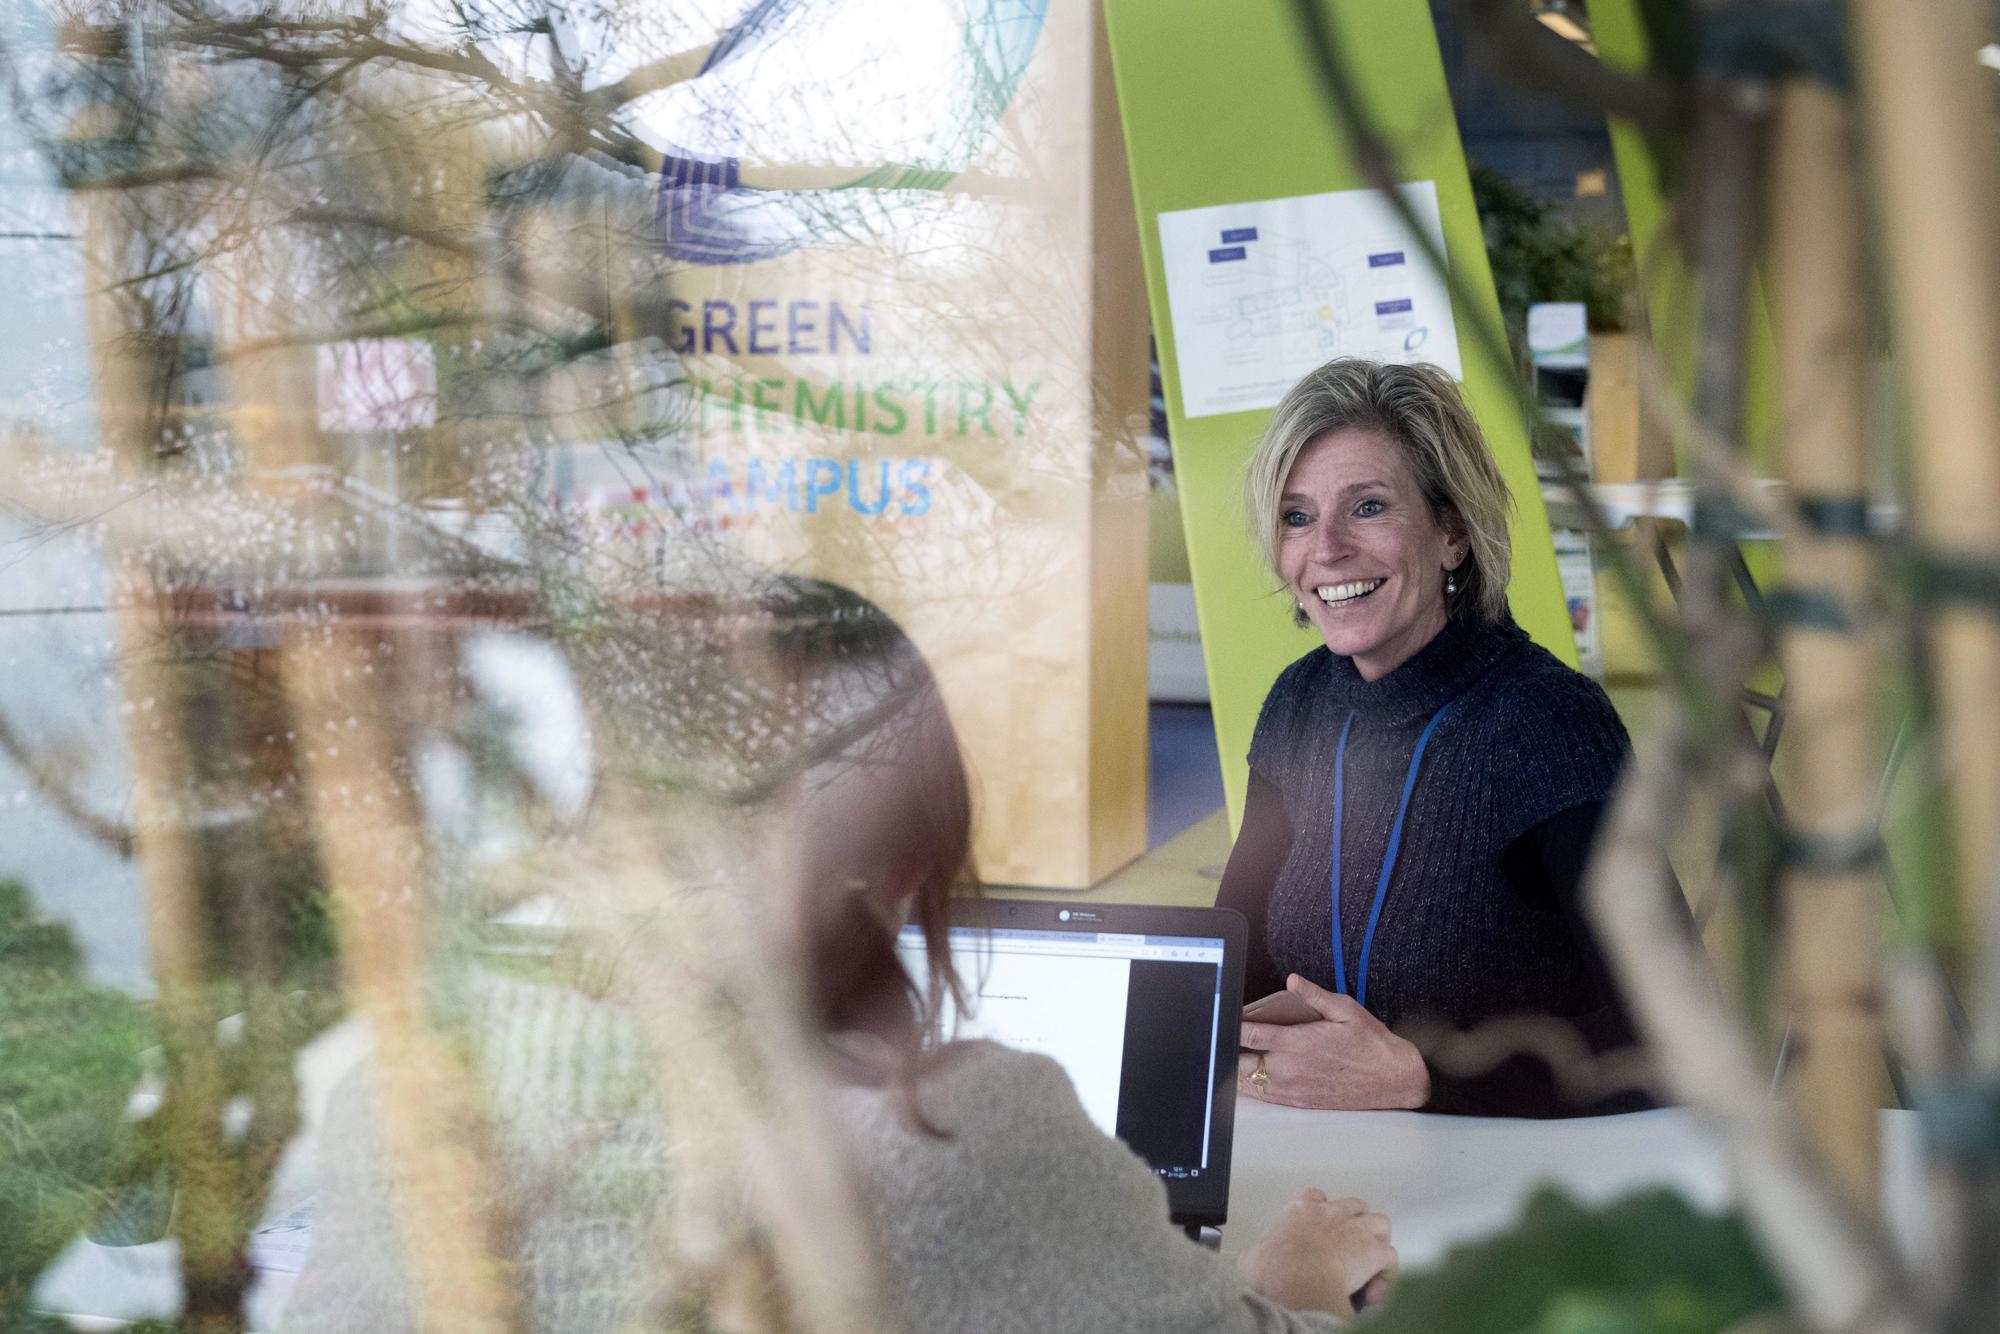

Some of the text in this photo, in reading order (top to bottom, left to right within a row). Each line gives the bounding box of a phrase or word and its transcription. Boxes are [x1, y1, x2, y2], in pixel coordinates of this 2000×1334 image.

[669, 299, 871, 354] GREEN
[688, 379, 1041, 438] HEMISTRY
[706, 457, 932, 516] AMPUS
